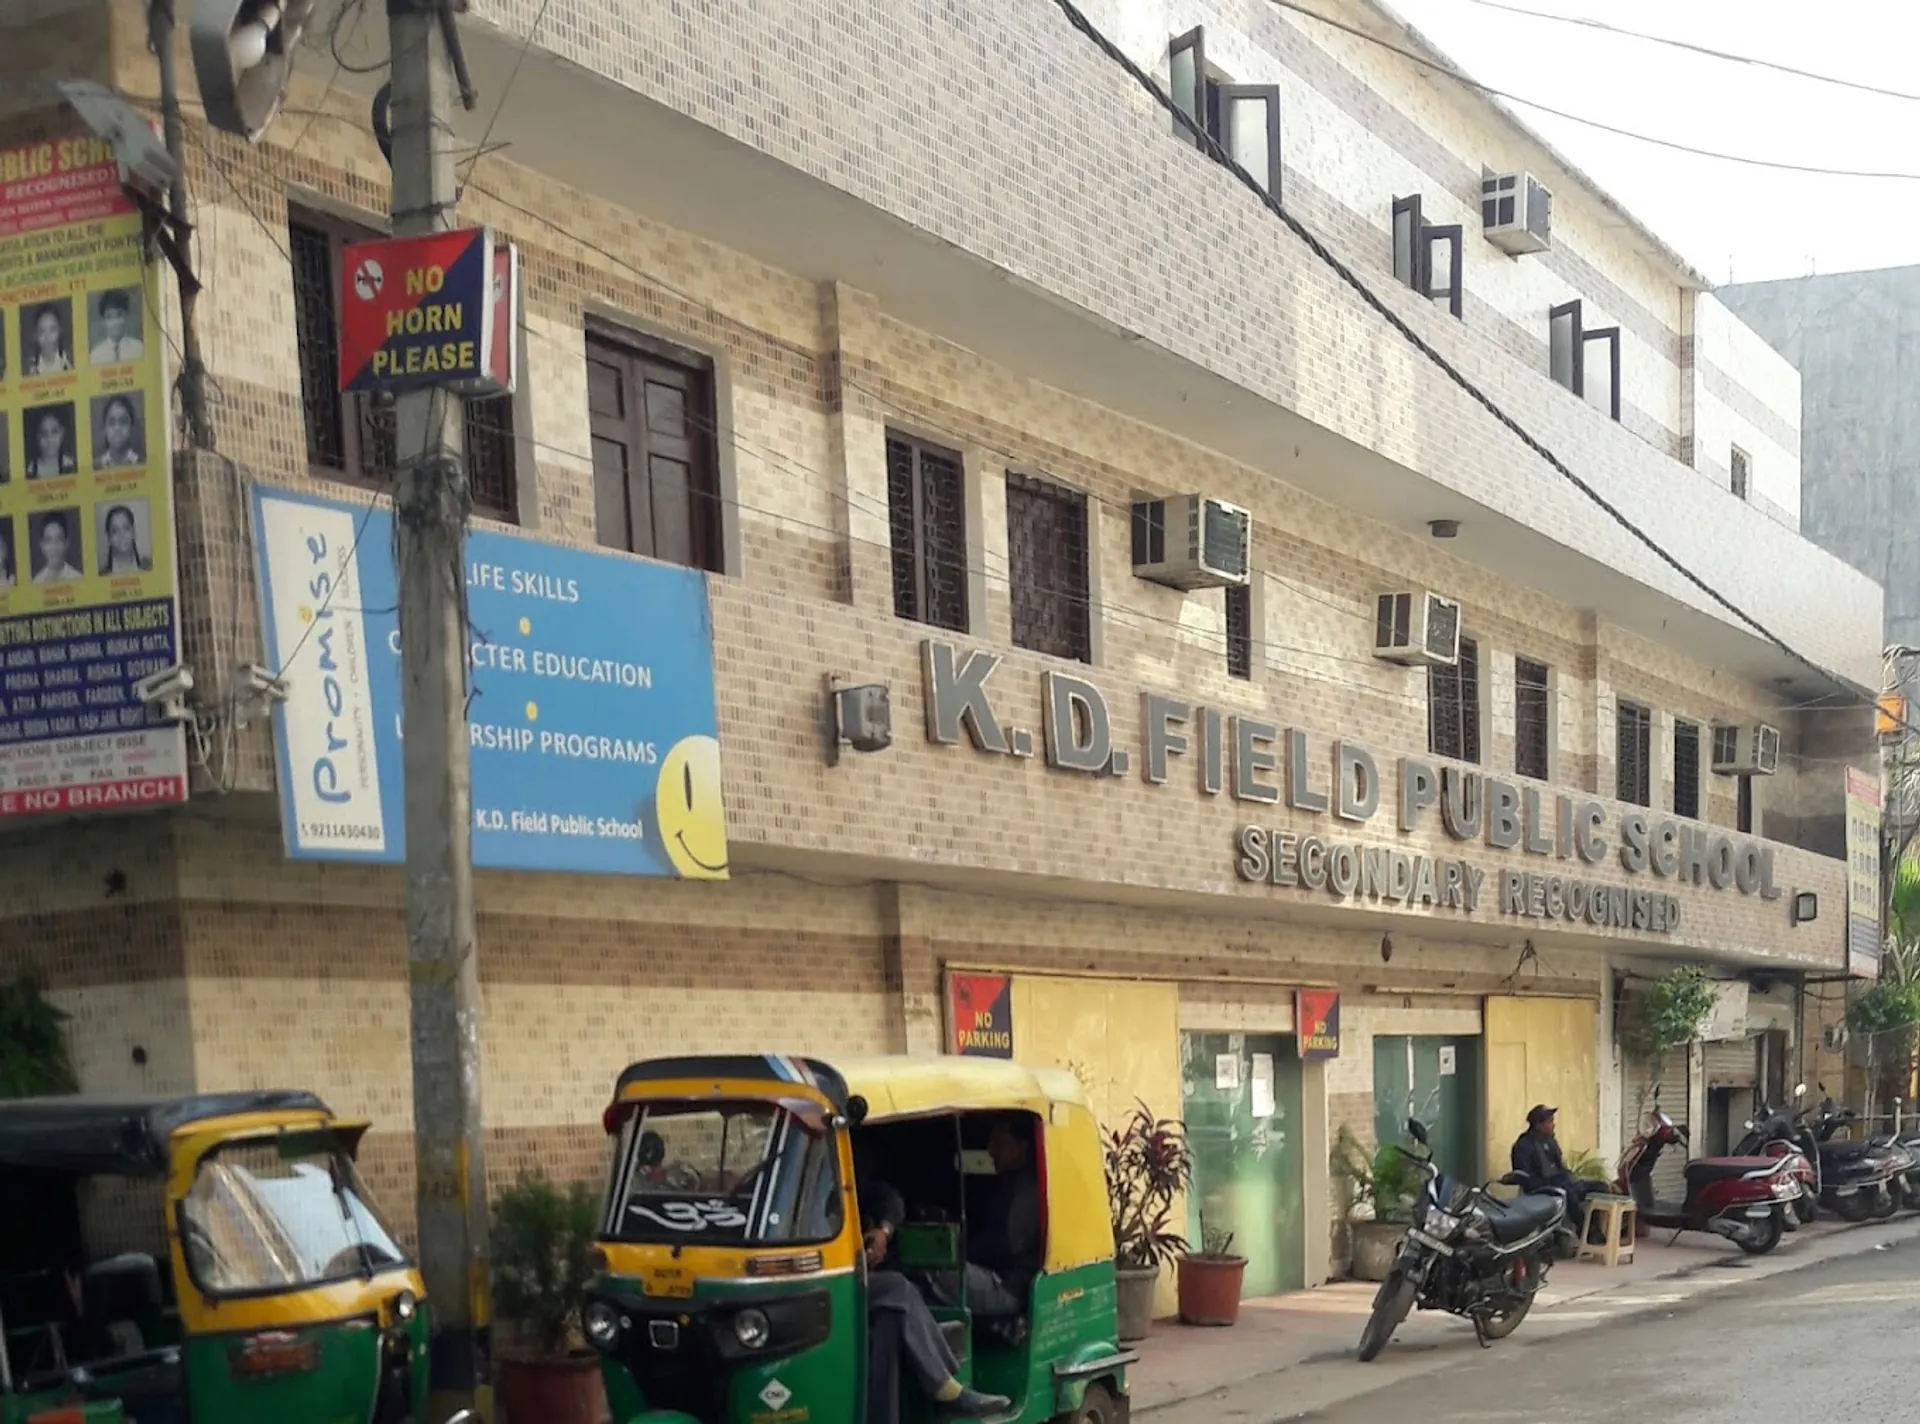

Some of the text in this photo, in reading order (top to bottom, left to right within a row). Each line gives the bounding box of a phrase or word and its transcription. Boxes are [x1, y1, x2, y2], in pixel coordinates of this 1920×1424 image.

[407, 264, 445, 296] NO
[386, 301, 463, 336] HORN
[372, 340, 475, 377] PLEASE
[511, 570, 579, 603] SKILLS
[388, 628, 652, 690] CCTER EDUCATION
[540, 729, 657, 766] PROGRAMS
[24, 789, 61, 811] NO
[68, 779, 175, 808] BRANCH
[1139, 690, 1381, 823] FIELD
[1398, 756, 1608, 864] PUBLIC
[1620, 812, 1783, 901] SCHOOL
[475, 807, 643, 840] K.D. Field Public School
[1237, 824, 1682, 934] SECONDARY RECOGNISED
[975, 1011, 993, 1029] NO
[1313, 1019, 1328, 1035] NO
[958, 1028, 1011, 1050] PARKING
